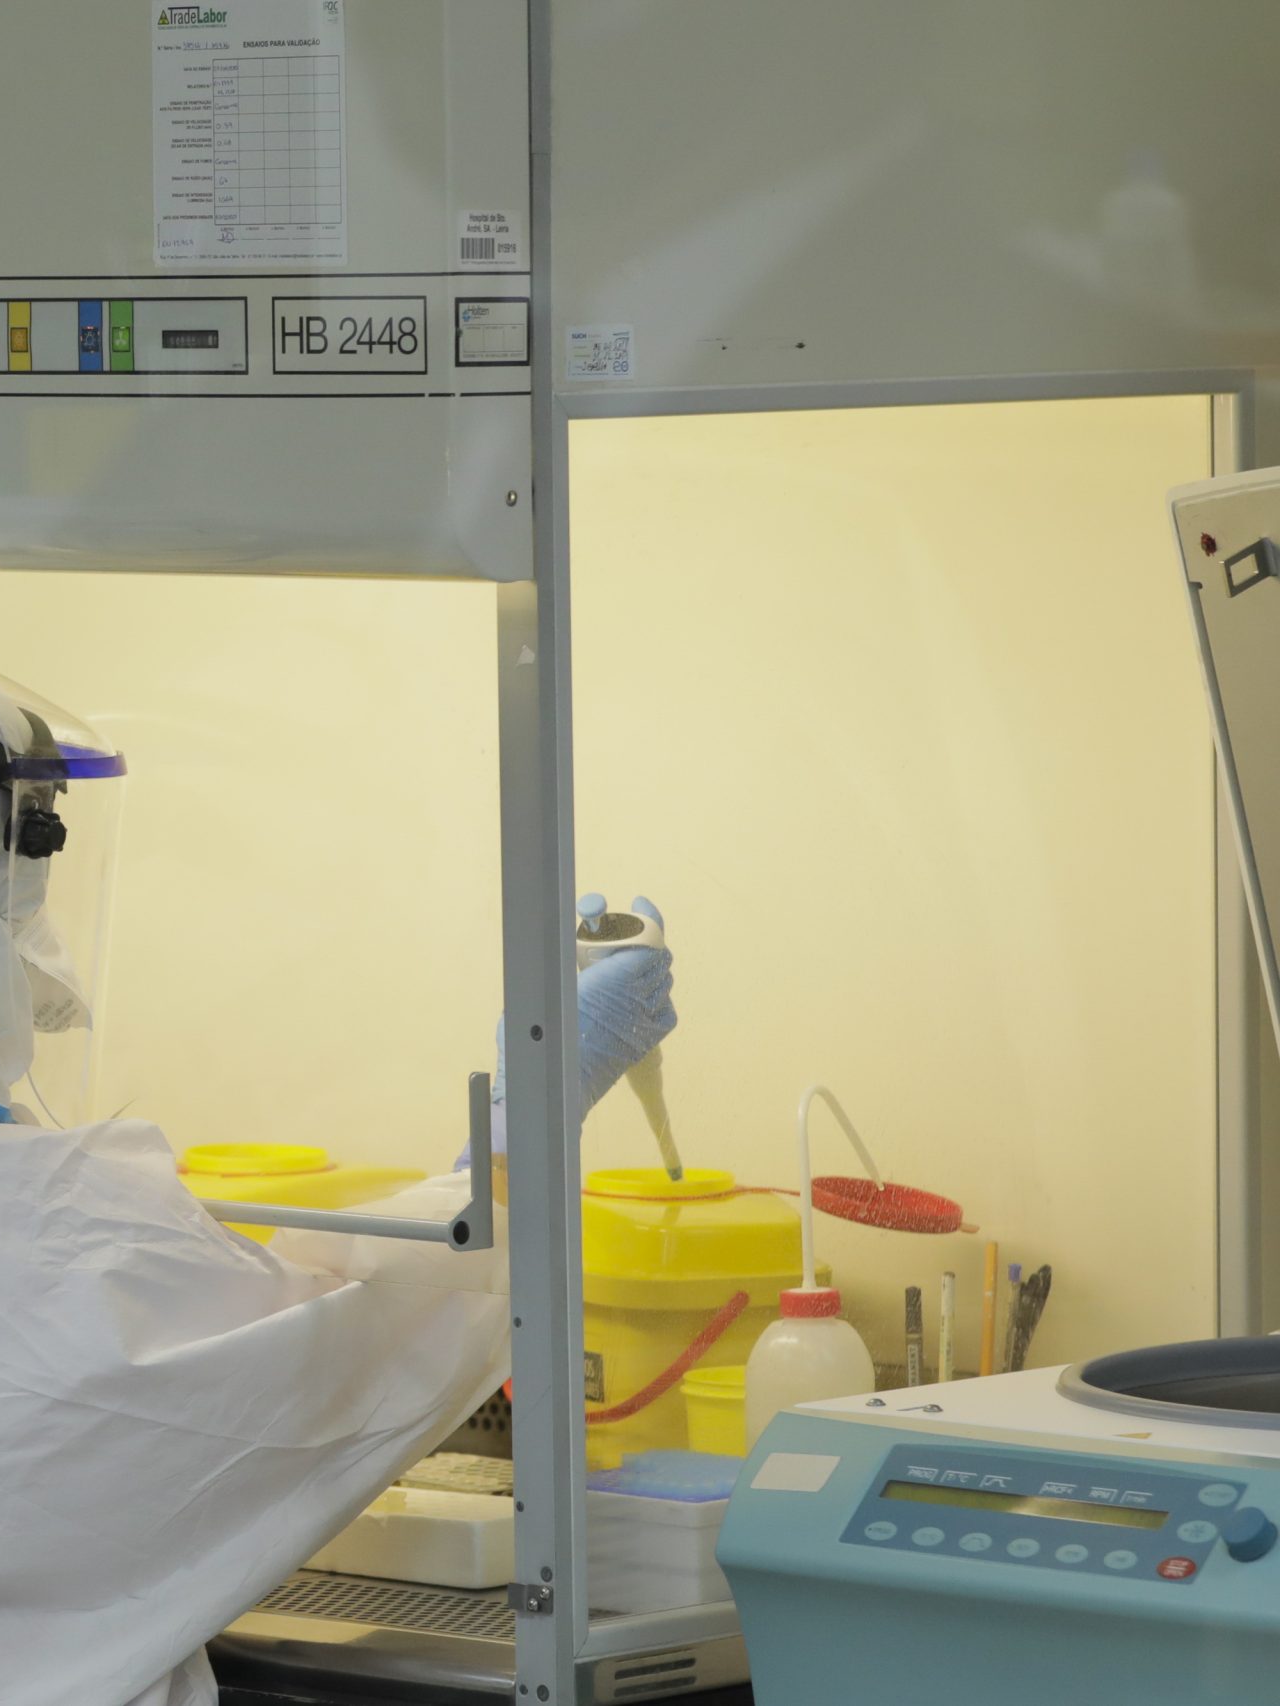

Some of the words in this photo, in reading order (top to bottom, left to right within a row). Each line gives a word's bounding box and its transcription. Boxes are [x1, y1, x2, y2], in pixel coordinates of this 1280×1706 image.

[167, 6, 227, 25] TradeLabor
[243, 40, 269, 48] ENSAIOS
[269, 39, 286, 47] PARA
[287, 37, 321, 46] VALIDAÇÃO
[281, 316, 328, 354] HB
[338, 316, 418, 355] 2448
